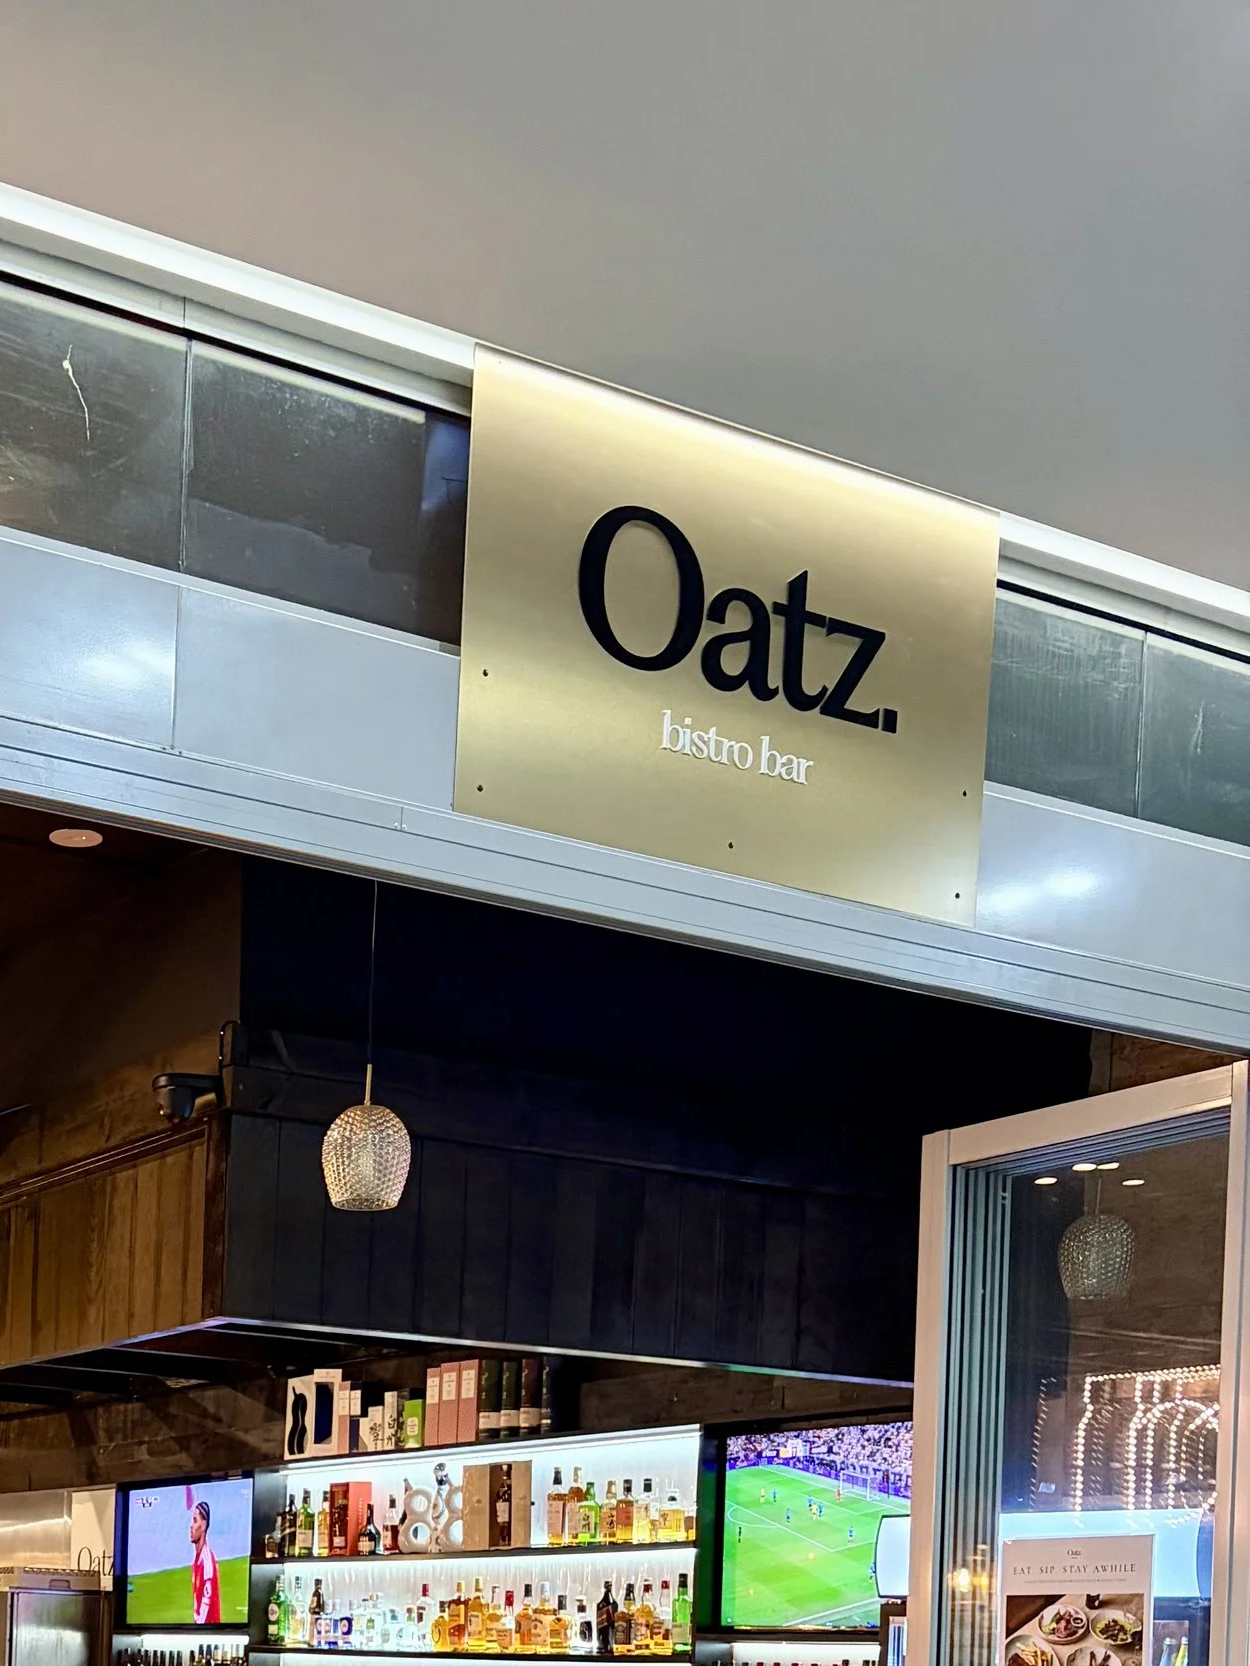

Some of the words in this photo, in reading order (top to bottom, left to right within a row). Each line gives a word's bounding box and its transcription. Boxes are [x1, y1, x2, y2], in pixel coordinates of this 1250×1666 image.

[660, 709, 753, 770] bistro
[758, 735, 814, 785] bar
[1062, 1564, 1088, 1574] STAY
